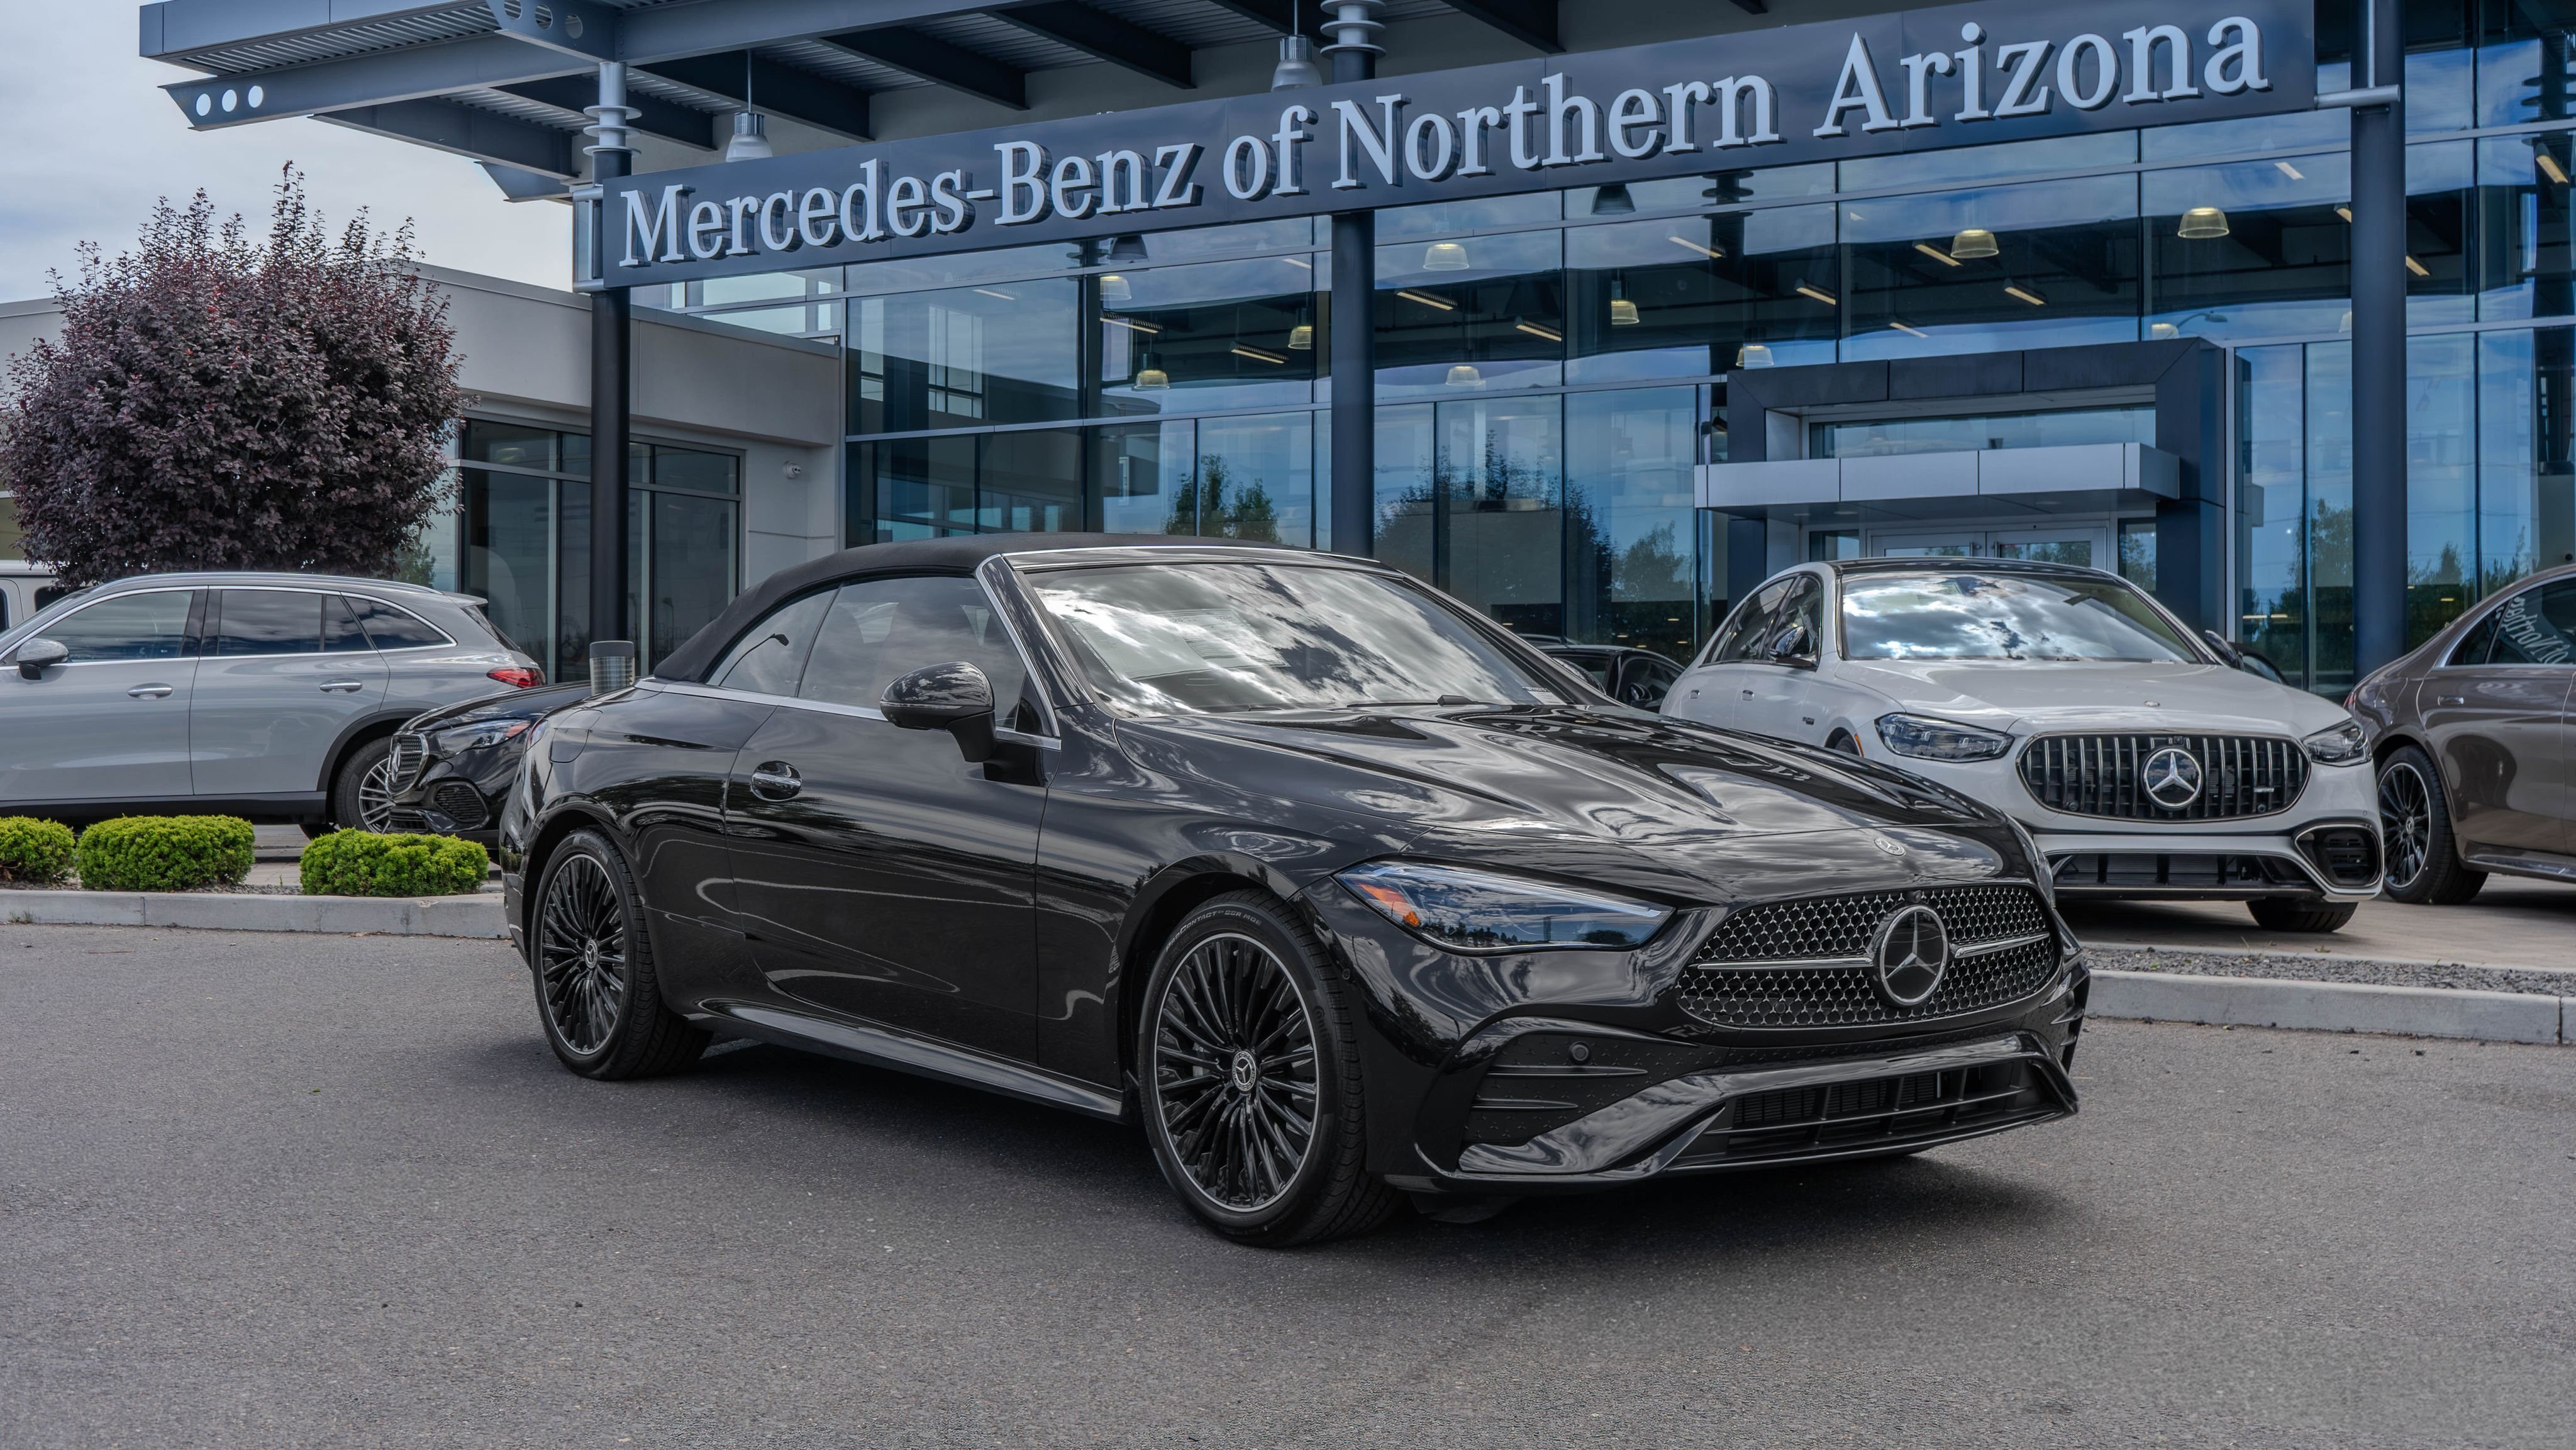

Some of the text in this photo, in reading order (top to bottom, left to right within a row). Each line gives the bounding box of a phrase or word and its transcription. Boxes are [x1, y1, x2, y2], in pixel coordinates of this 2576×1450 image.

[619, 16, 2272, 268] Mercedes-Benz of Northern Arizona
